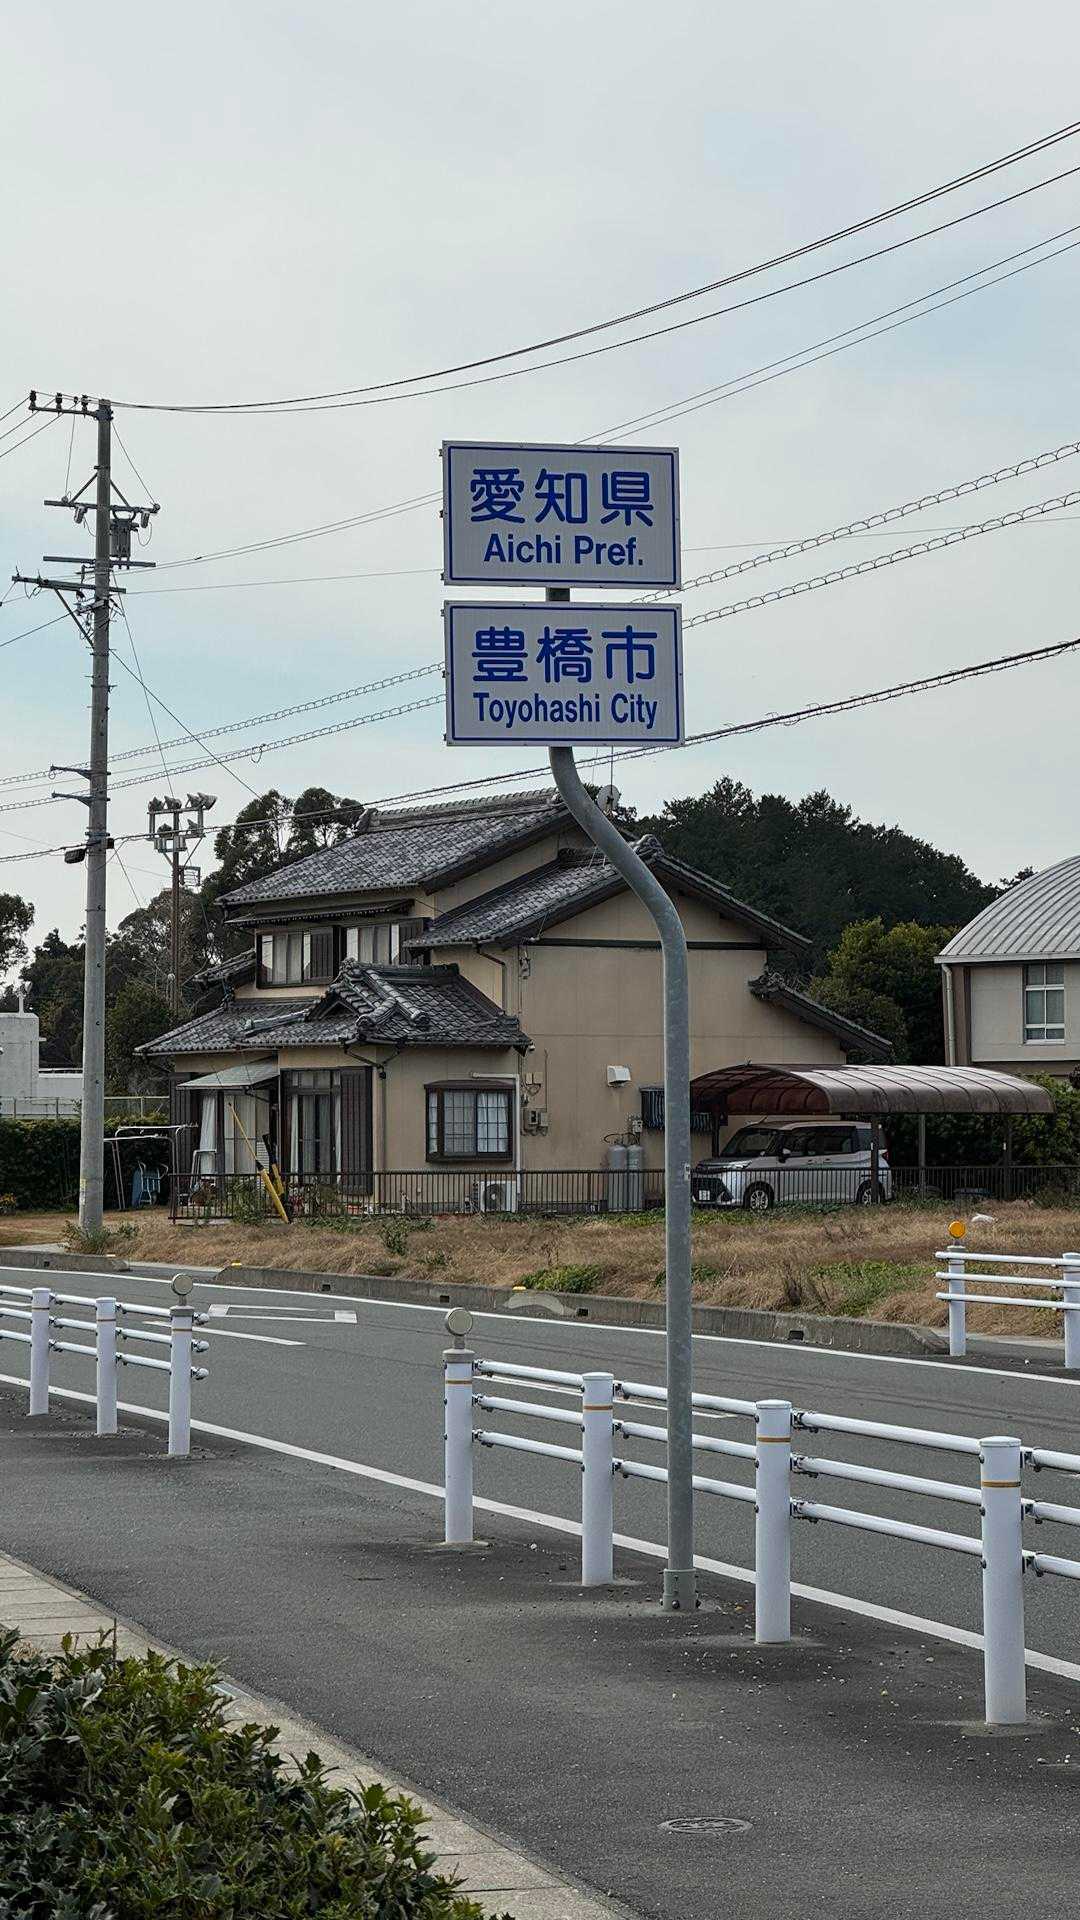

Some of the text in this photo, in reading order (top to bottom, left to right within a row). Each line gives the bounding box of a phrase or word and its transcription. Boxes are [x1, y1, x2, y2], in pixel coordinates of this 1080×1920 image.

[470, 468, 654, 527] 愛知県
[483, 533, 643, 566] Aichi Pref.
[472, 625, 658, 684] 豊橋市
[473, 692, 658, 730] Toyohashi City
